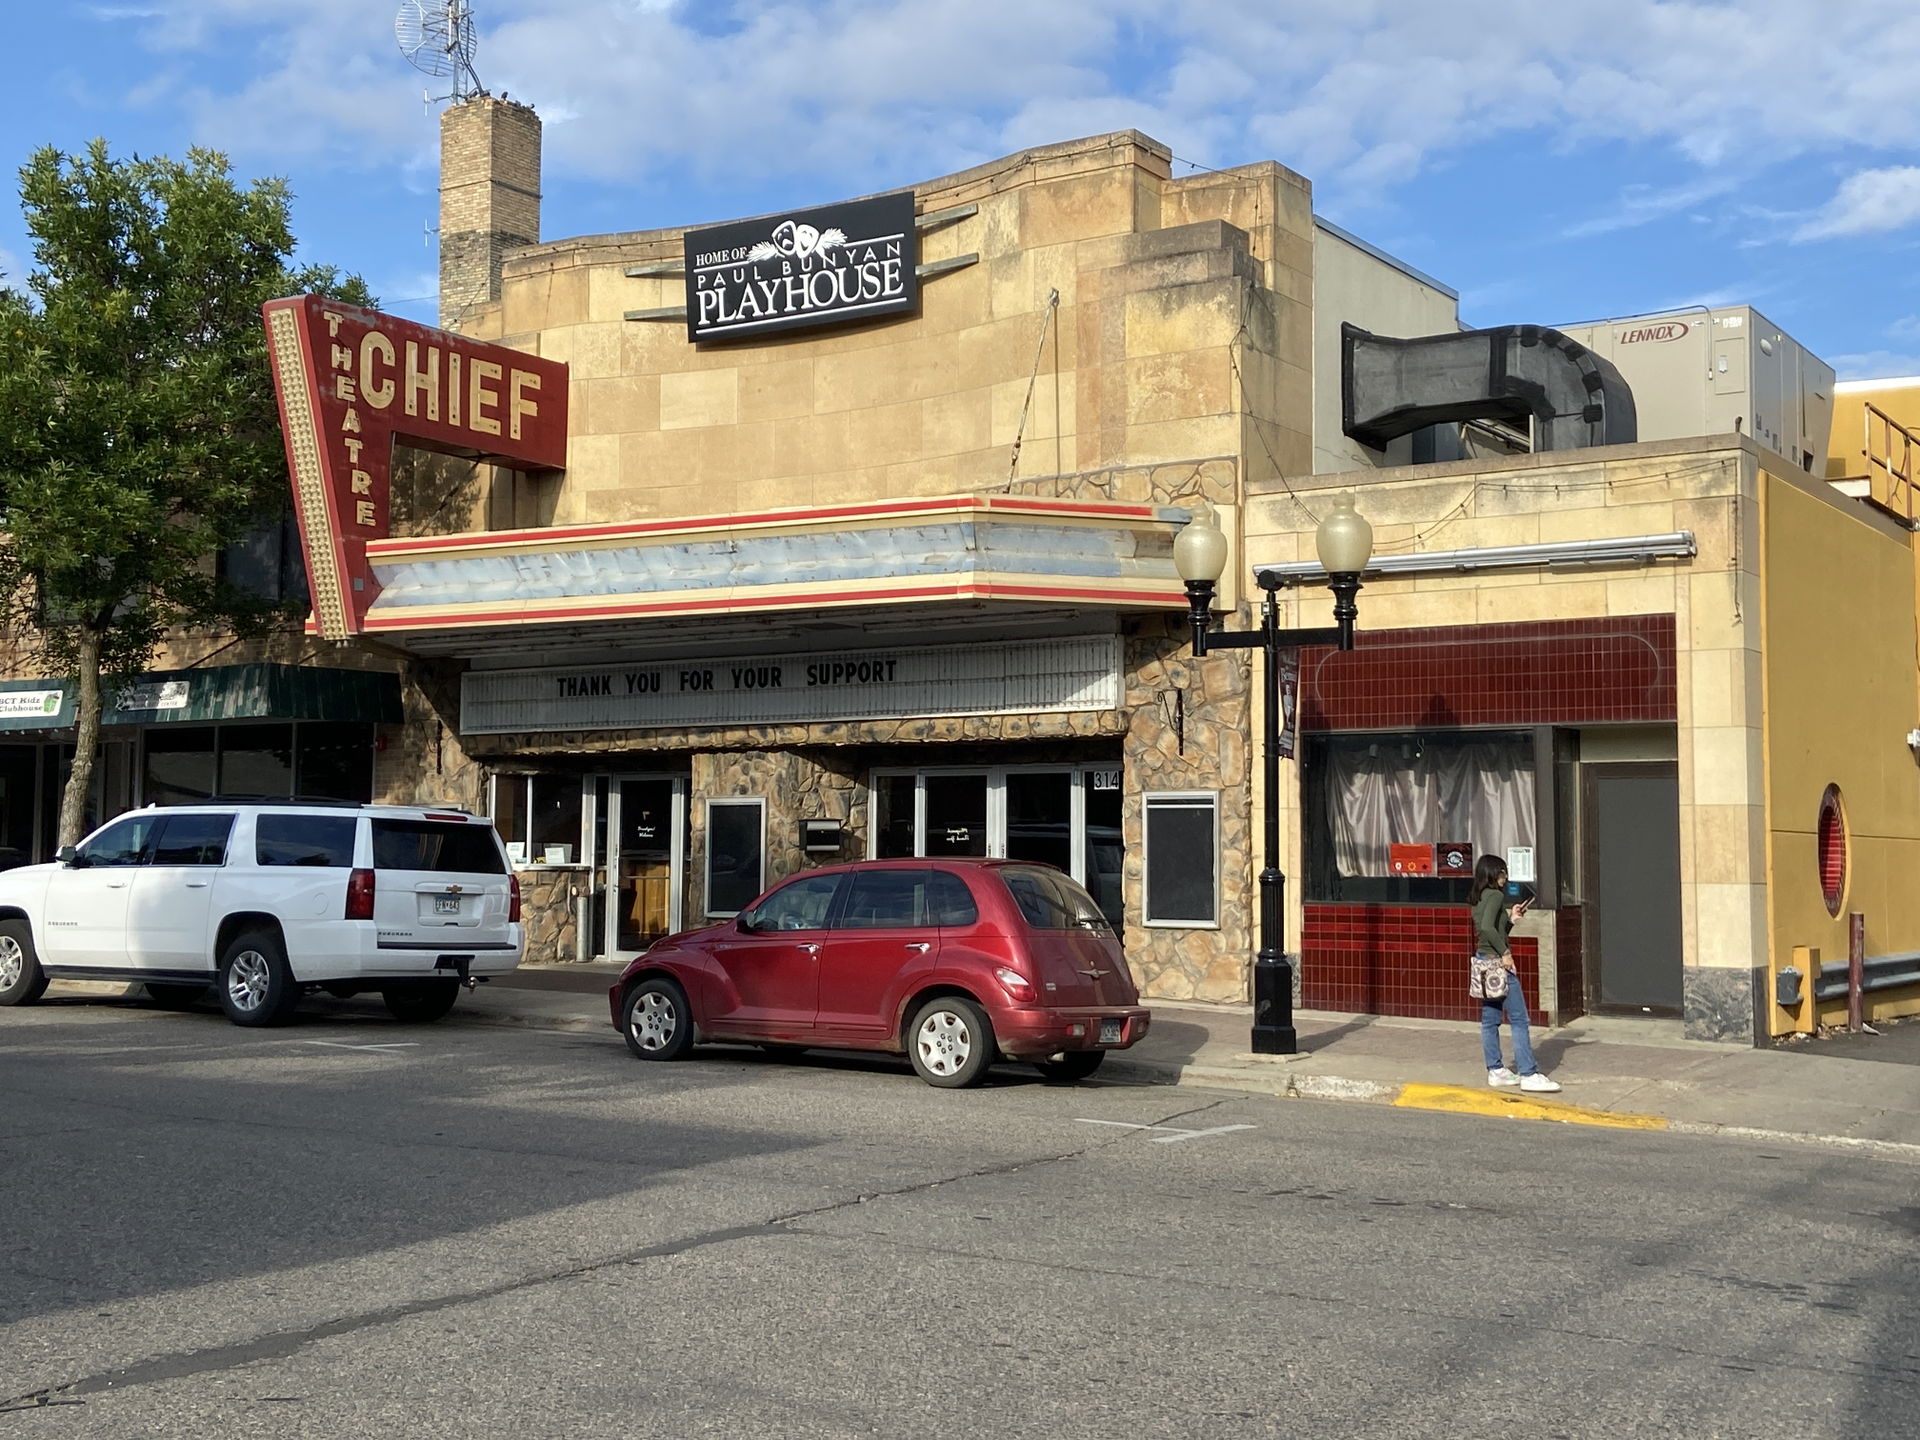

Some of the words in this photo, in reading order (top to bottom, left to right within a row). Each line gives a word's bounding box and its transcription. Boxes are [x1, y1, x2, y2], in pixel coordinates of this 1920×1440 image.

[696, 250, 730, 266] HOME
[731, 247, 747, 262] OF
[697, 265, 761, 288] PAUL
[782, 241, 901, 275] BUNYAN
[696, 258, 904, 325] PLAYHOUSE
[1620, 325, 1676, 344] LENNOX
[359, 331, 541, 441] CHIEF
[323, 310, 376, 527] THEATRE
[556, 676, 612, 698] THANK
[625, 672, 661, 693] YOU
[680, 669, 713, 691] FOR
[731, 666, 782, 689] YOUR
[806, 660, 897, 686] SUPPORT
[19, 696, 41, 704] Kidz
[1095, 772, 1118, 788] 314
